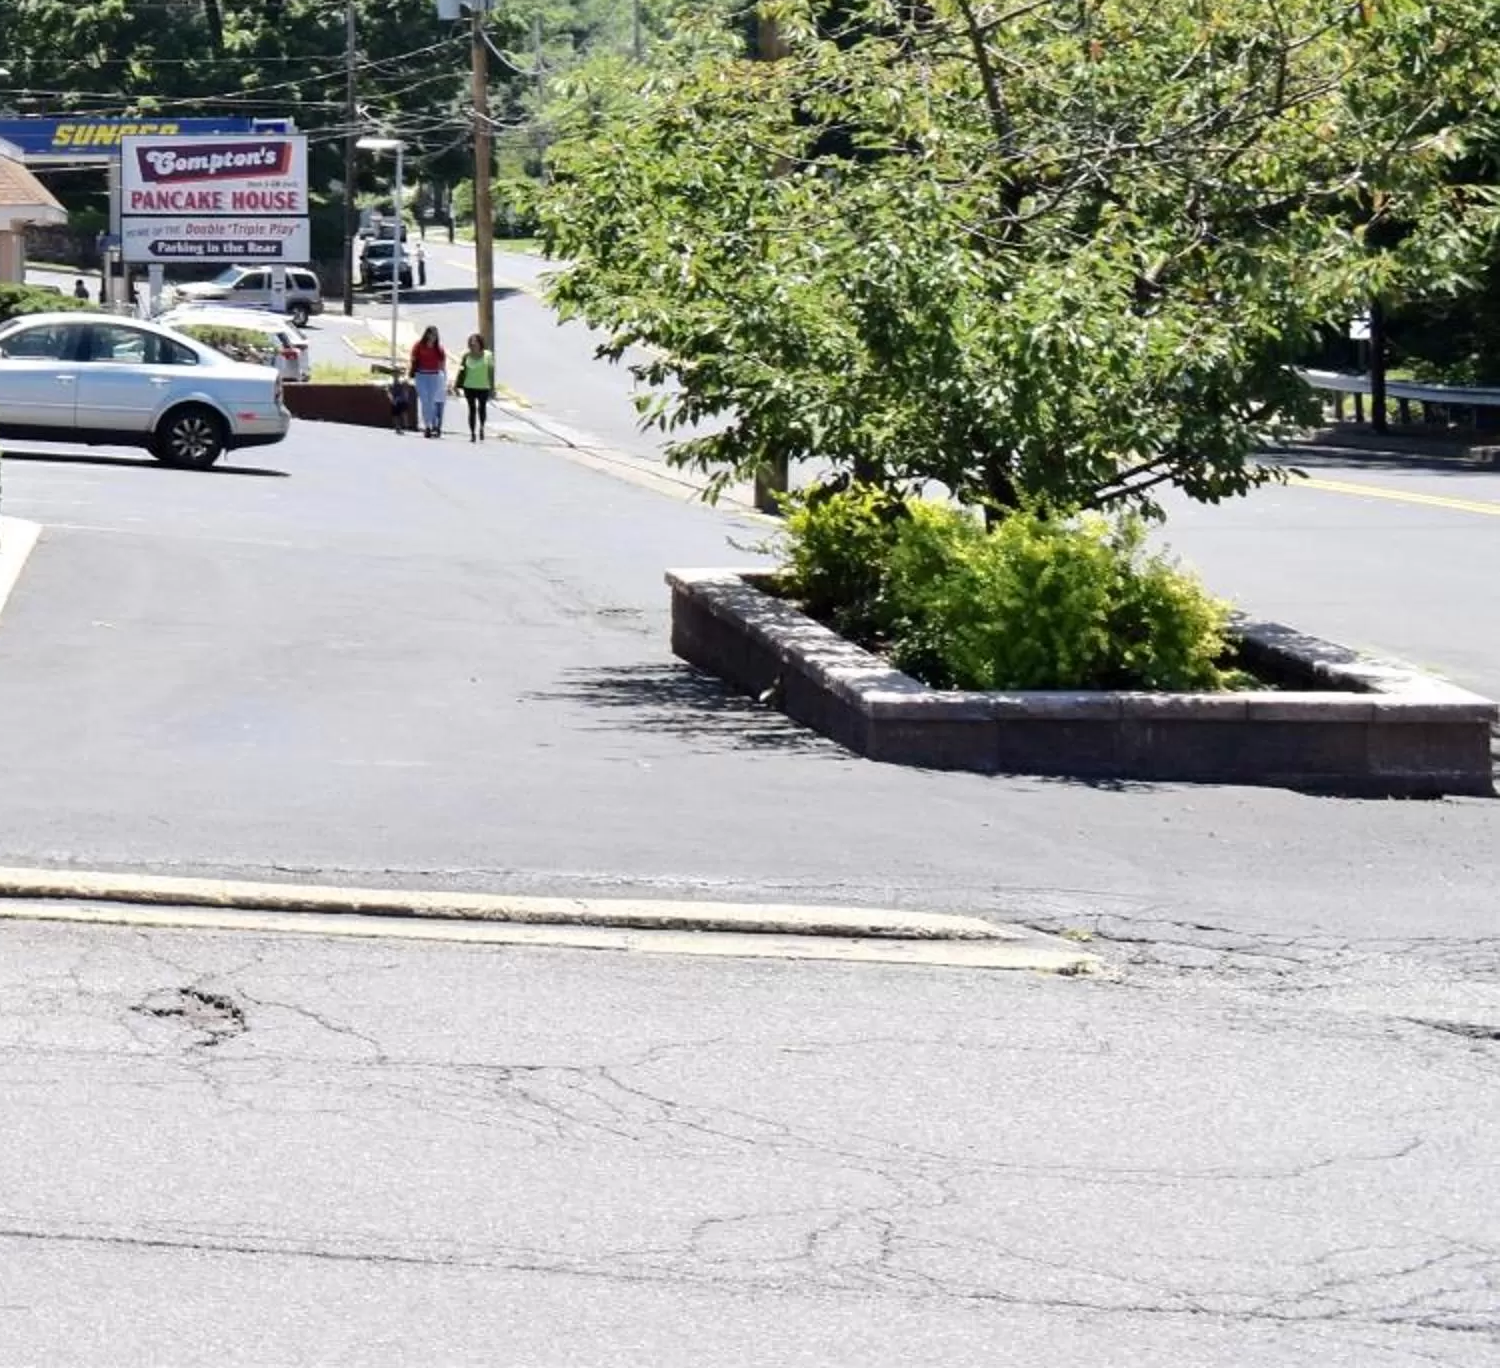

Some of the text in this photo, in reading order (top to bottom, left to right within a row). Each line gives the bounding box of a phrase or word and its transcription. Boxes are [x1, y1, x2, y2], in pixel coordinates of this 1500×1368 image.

[145, 146, 278, 175] Compton's
[131, 190, 299, 210] PANCAKE HOUSE
[186, 222, 225, 235] Double
[157, 241, 278, 255] Parking in the Rear
